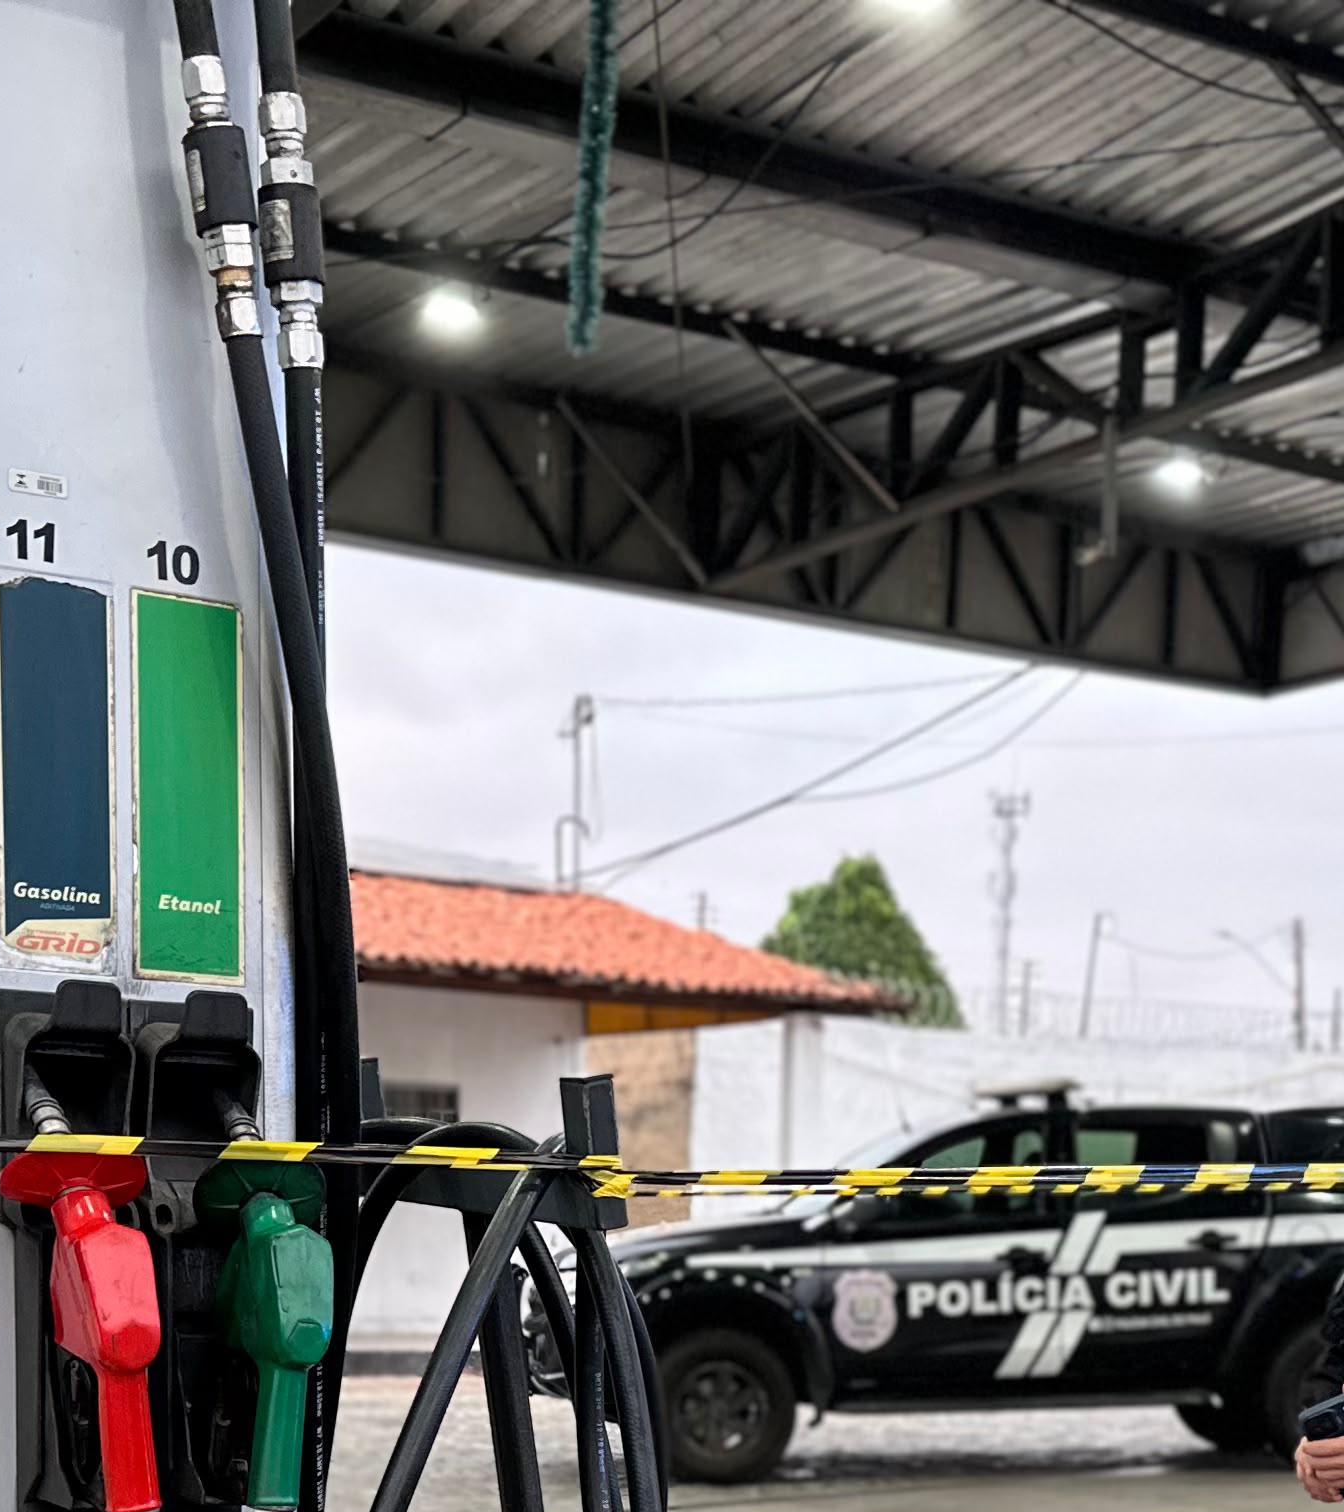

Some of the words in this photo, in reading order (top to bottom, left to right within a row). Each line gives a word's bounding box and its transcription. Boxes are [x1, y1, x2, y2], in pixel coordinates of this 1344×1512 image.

[6, 518, 56, 564] 11
[146, 540, 200, 586] 10
[13, 881, 101, 905] Gasolina
[158, 893, 221, 916] Etanol
[16, 932, 101, 955] GRID
[907, 1269, 1095, 1318] POLÍCIA
[1104, 1268, 1230, 1308] CIVIL
